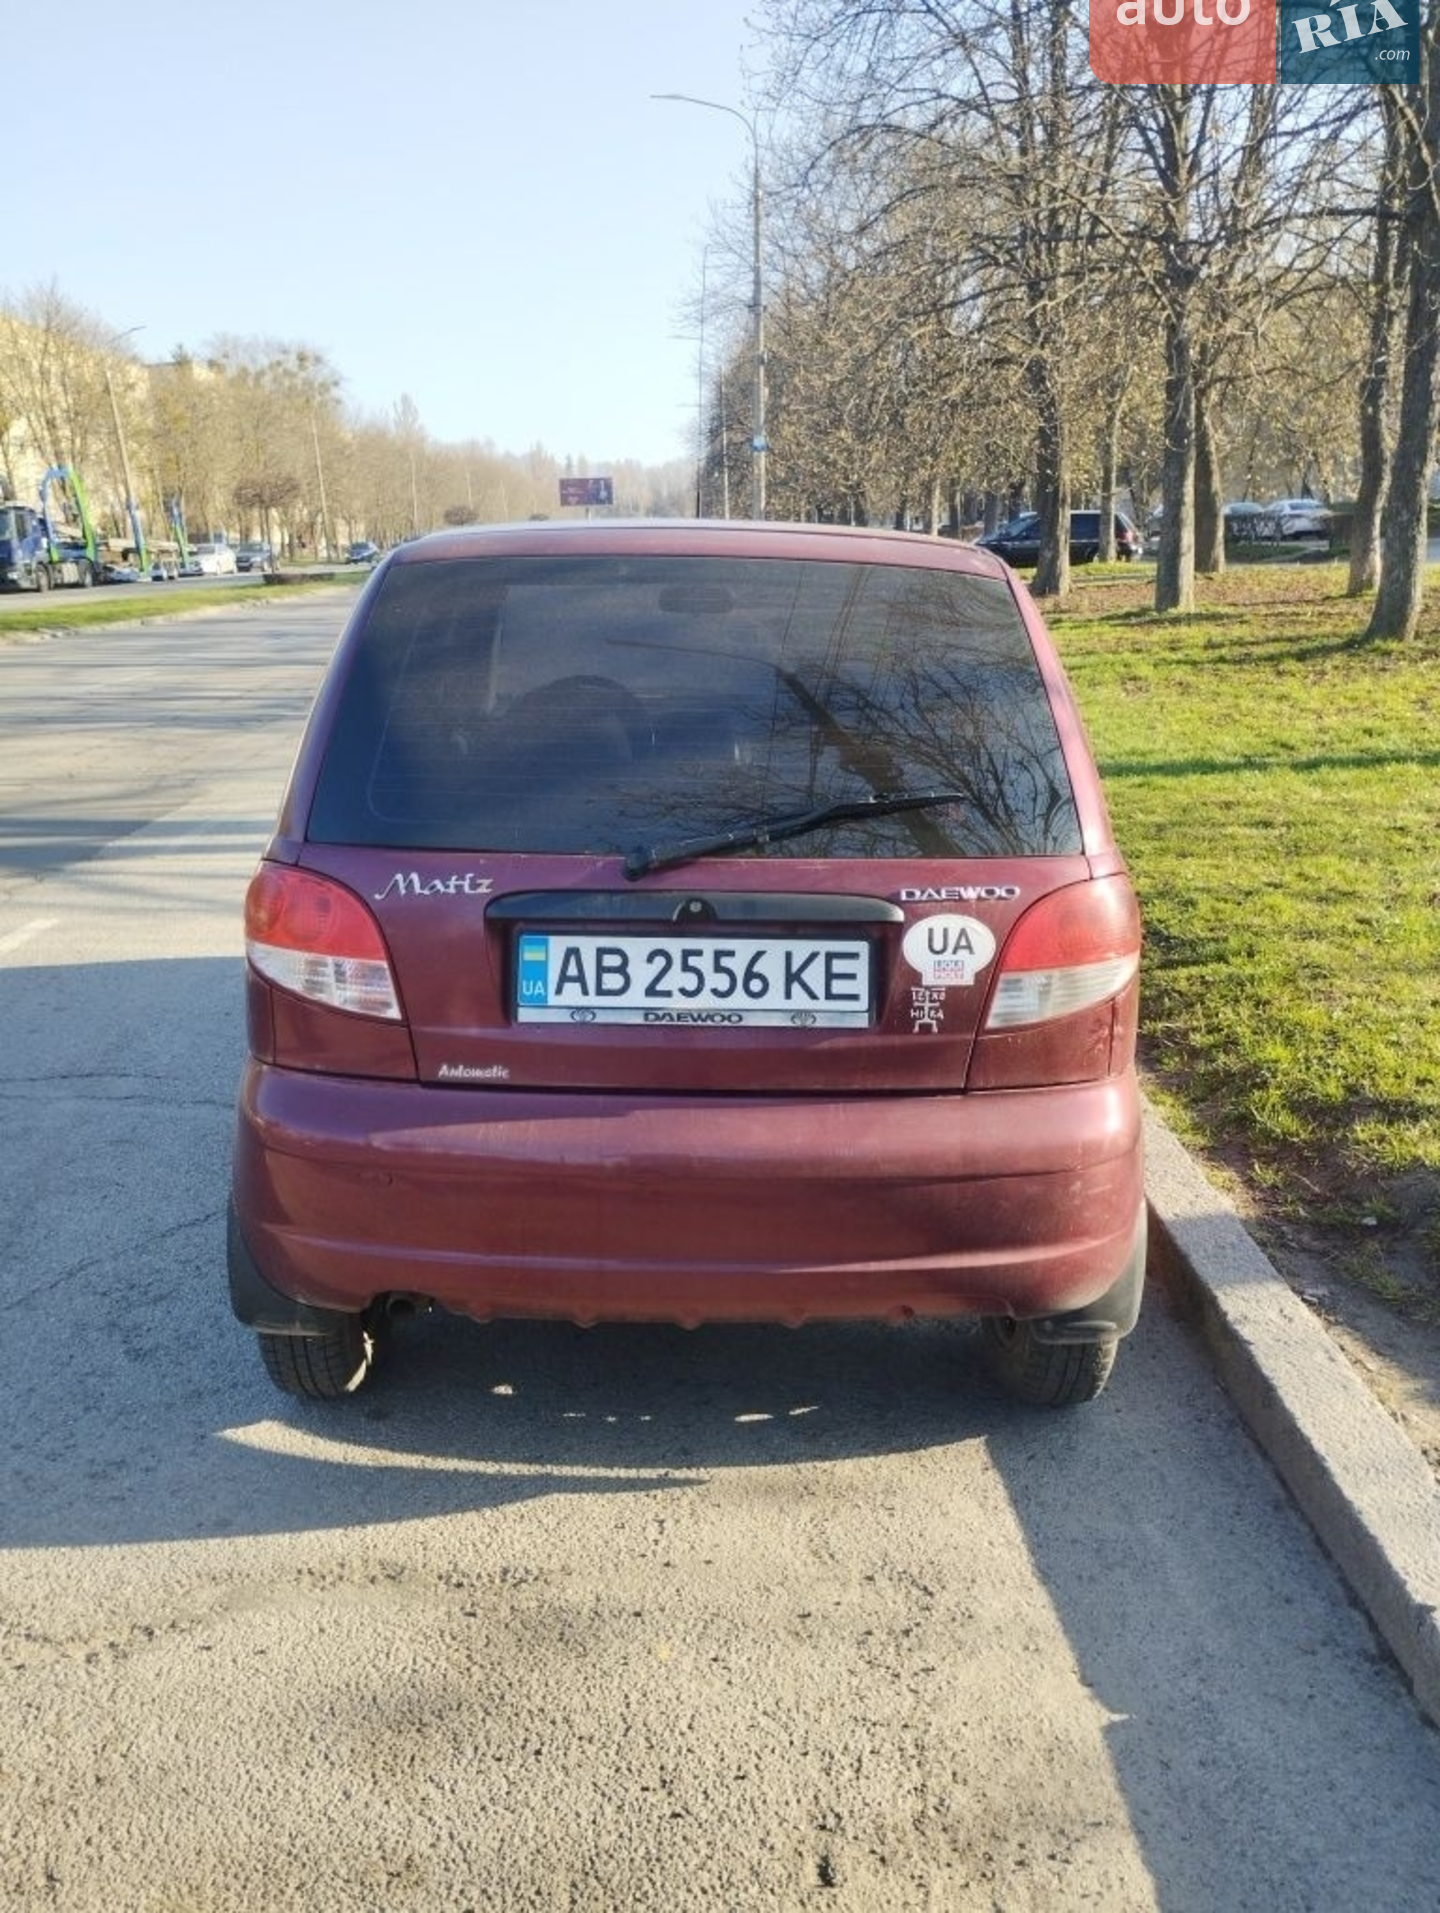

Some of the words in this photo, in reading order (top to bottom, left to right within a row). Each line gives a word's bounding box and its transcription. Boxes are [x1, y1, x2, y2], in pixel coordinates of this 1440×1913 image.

[374, 871, 494, 900] Matiz
[901, 885, 1021, 901] DAEWOO
[927, 927, 975, 955] UA
[554, 946, 631, 996] AB
[643, 948, 770, 999] 2556
[784, 951, 861, 1001] KE
[522, 980, 546, 996] UA
[643, 1012, 743, 1024] DAEWOO
[438, 1064, 510, 1079] Automatic
